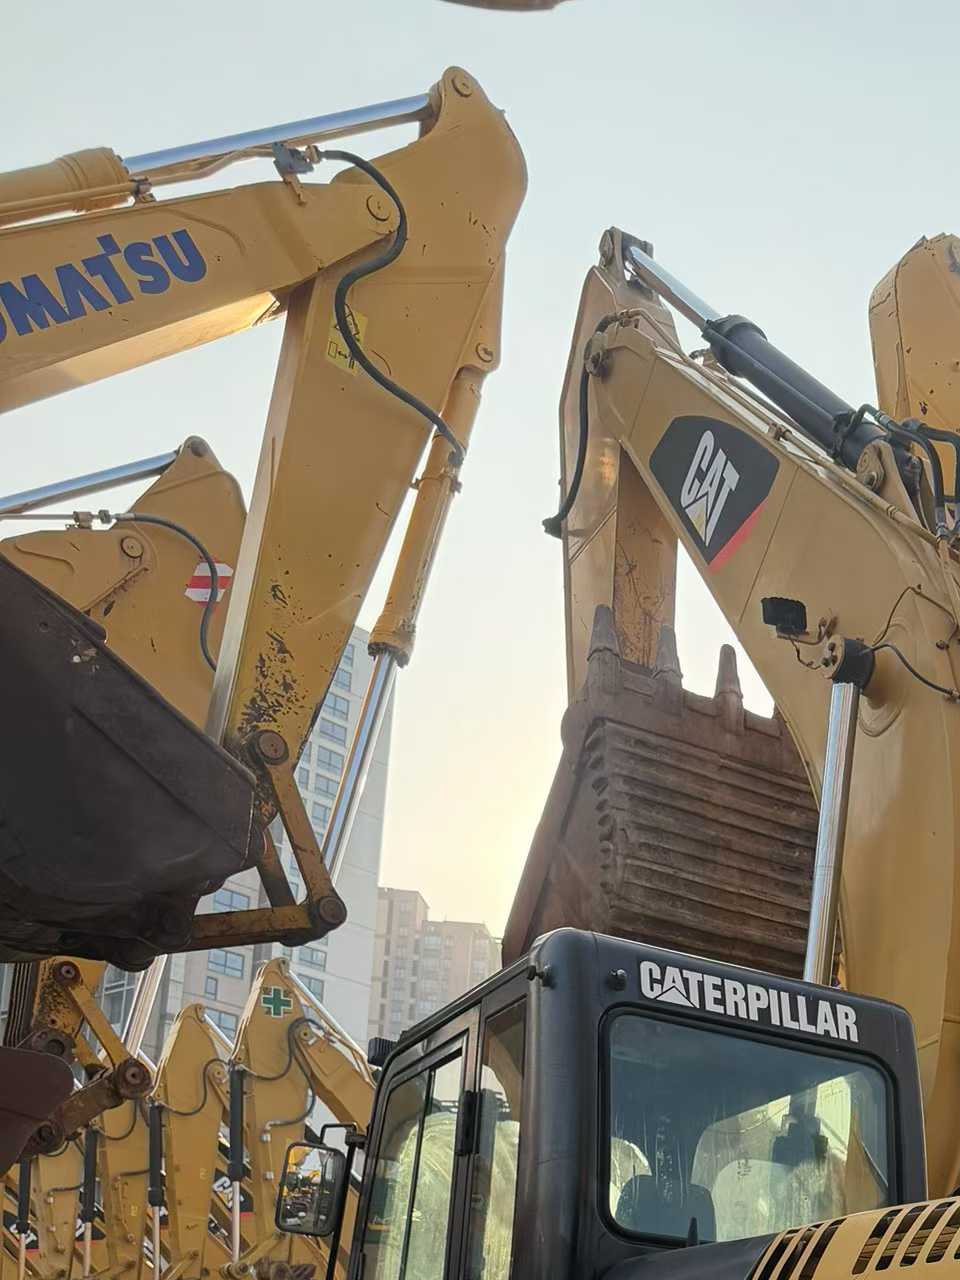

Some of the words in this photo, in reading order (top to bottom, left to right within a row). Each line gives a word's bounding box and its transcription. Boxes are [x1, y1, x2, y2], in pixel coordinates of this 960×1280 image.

[0, 229, 207, 343] MATSU
[680, 430, 740, 547] CAT
[640, 961, 859, 1043] CATERPILLAR
